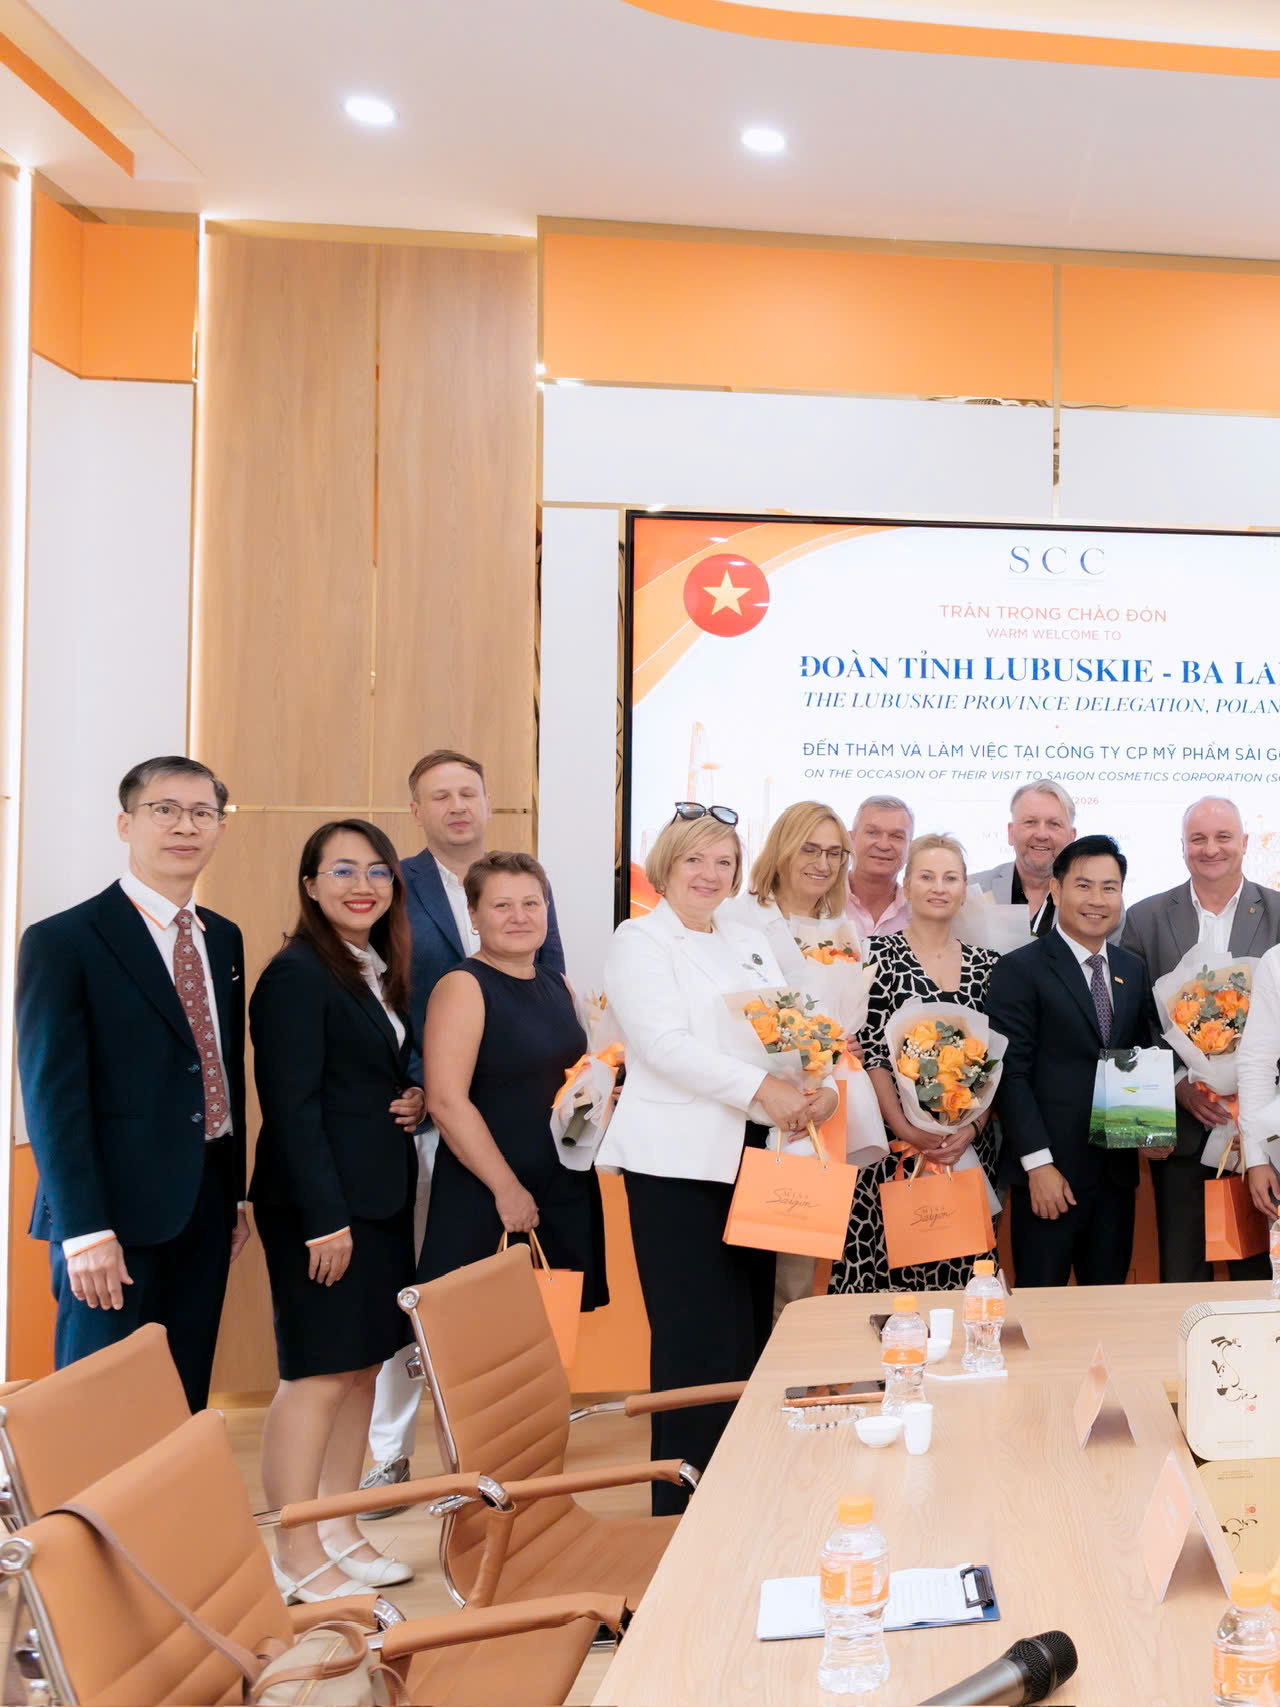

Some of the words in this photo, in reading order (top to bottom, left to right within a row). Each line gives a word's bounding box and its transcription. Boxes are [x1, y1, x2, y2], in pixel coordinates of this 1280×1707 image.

[1009, 545, 1105, 575] SCC
[996, 605, 1061, 622] TRỌNG
[1067, 604, 1120, 622] CHÀO
[1126, 605, 1167, 623] ĐÓN
[986, 628, 1028, 639] WARM
[1032, 628, 1099, 641] WELCOME
[1104, 630, 1122, 641] TO
[800, 649, 889, 679] ĐOÀN
[898, 649, 975, 680] TỈNH
[984, 656, 1153, 683] LUBUSKIE
[1181, 660, 1224, 684] BA
[804, 691, 847, 708] THE
[851, 692, 958, 710] LUBUSKIE
[963, 694, 1070, 711] PROVINCE
[1075, 696, 1209, 714] DELEGATION,
[802, 738, 839, 756] ĐẾN
[845, 740, 894, 757] THĂM
[900, 740, 923, 757] VÀ
[928, 740, 964, 758] LÀM
[969, 741, 1009, 761] VIỆC
[1014, 744, 1040, 762] TẠI
[1045, 742, 1095, 760] CÔNG
[1100, 745, 1120, 760] TY
[1126, 746, 1148, 761] CP
[1153, 743, 1177, 761] MỸ
[1183, 741, 1230, 762] PHẨM
[1235, 744, 1261, 761] SÀI
[804, 768, 825, 778] ON
[828, 768, 853, 779] THE
[856, 769, 926, 780] OCCASION
[929, 769, 948, 780] OF
[951, 770, 988, 780] THEIR
[991, 770, 1023, 780] VISIT
[1026, 770, 1043, 781] TO
[1046, 771, 1095, 782] SAIGON
[1098, 771, 1169, 782] COSMETICS
[1172, 772, 1263, 783] CORPORATION
